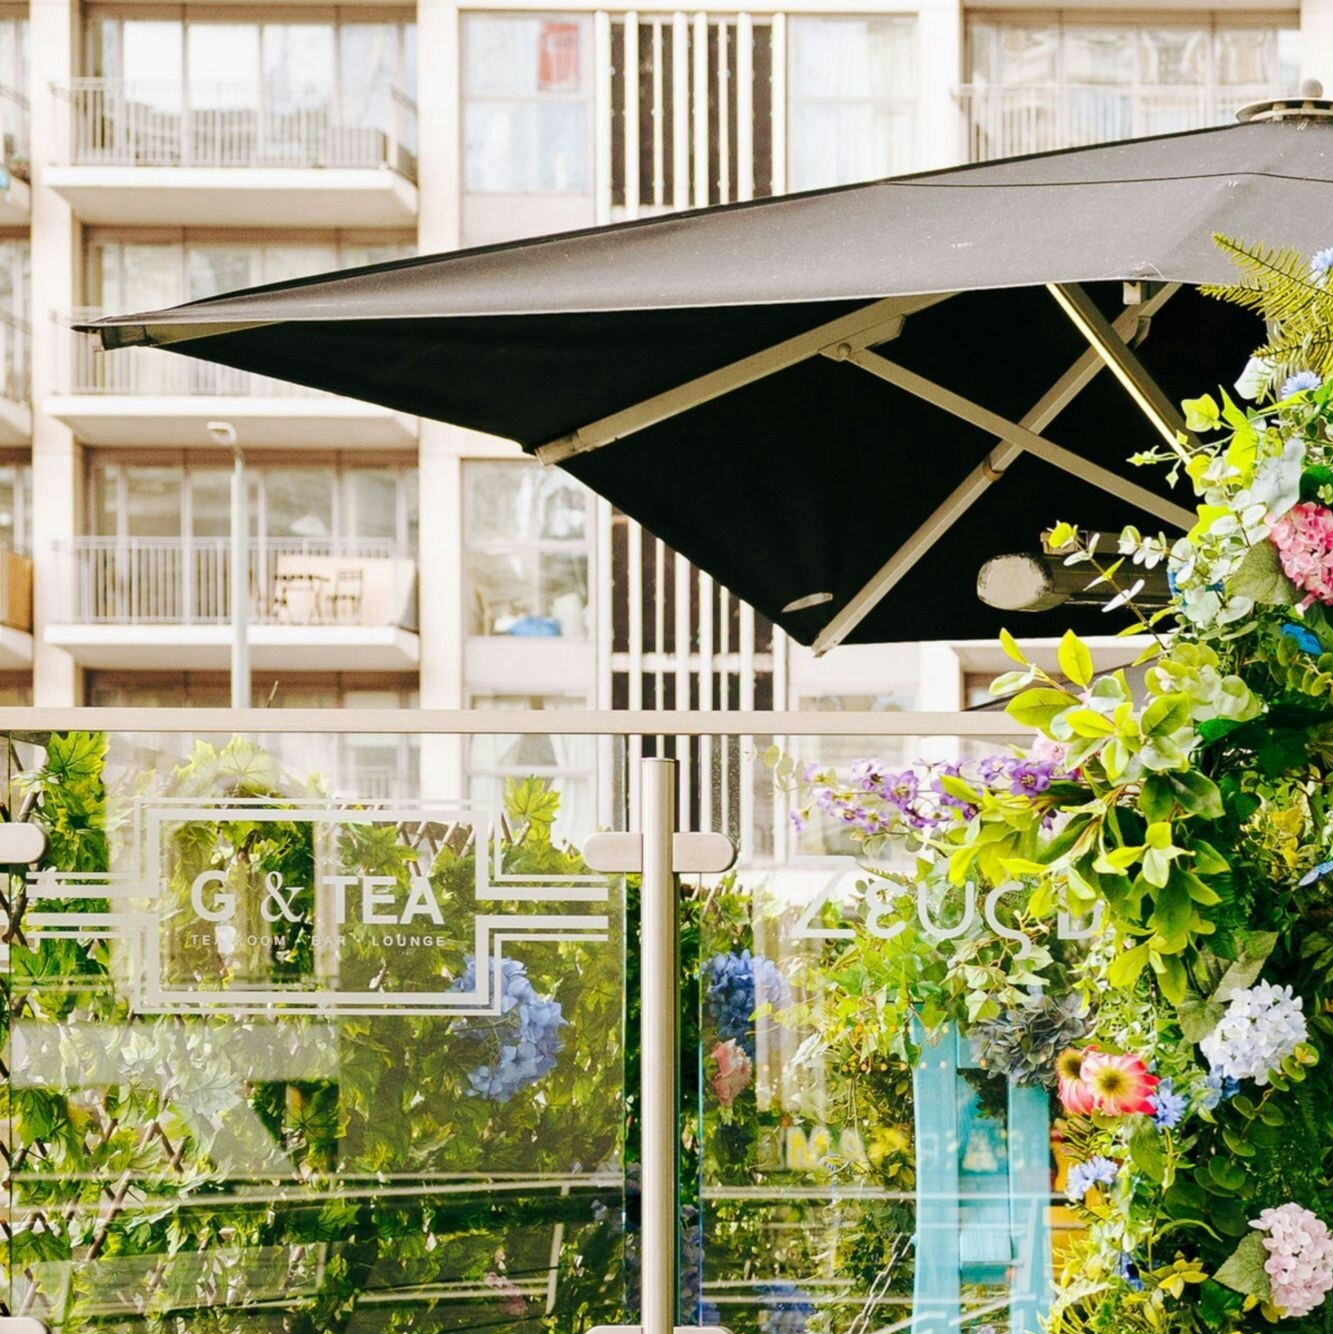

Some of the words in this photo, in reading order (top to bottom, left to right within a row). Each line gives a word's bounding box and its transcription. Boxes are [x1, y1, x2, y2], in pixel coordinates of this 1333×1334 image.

[190, 869, 237, 923] G
[260, 870, 305, 923] &
[322, 875, 446, 925] TEA
[371, 935, 445, 948] LOUNGE
